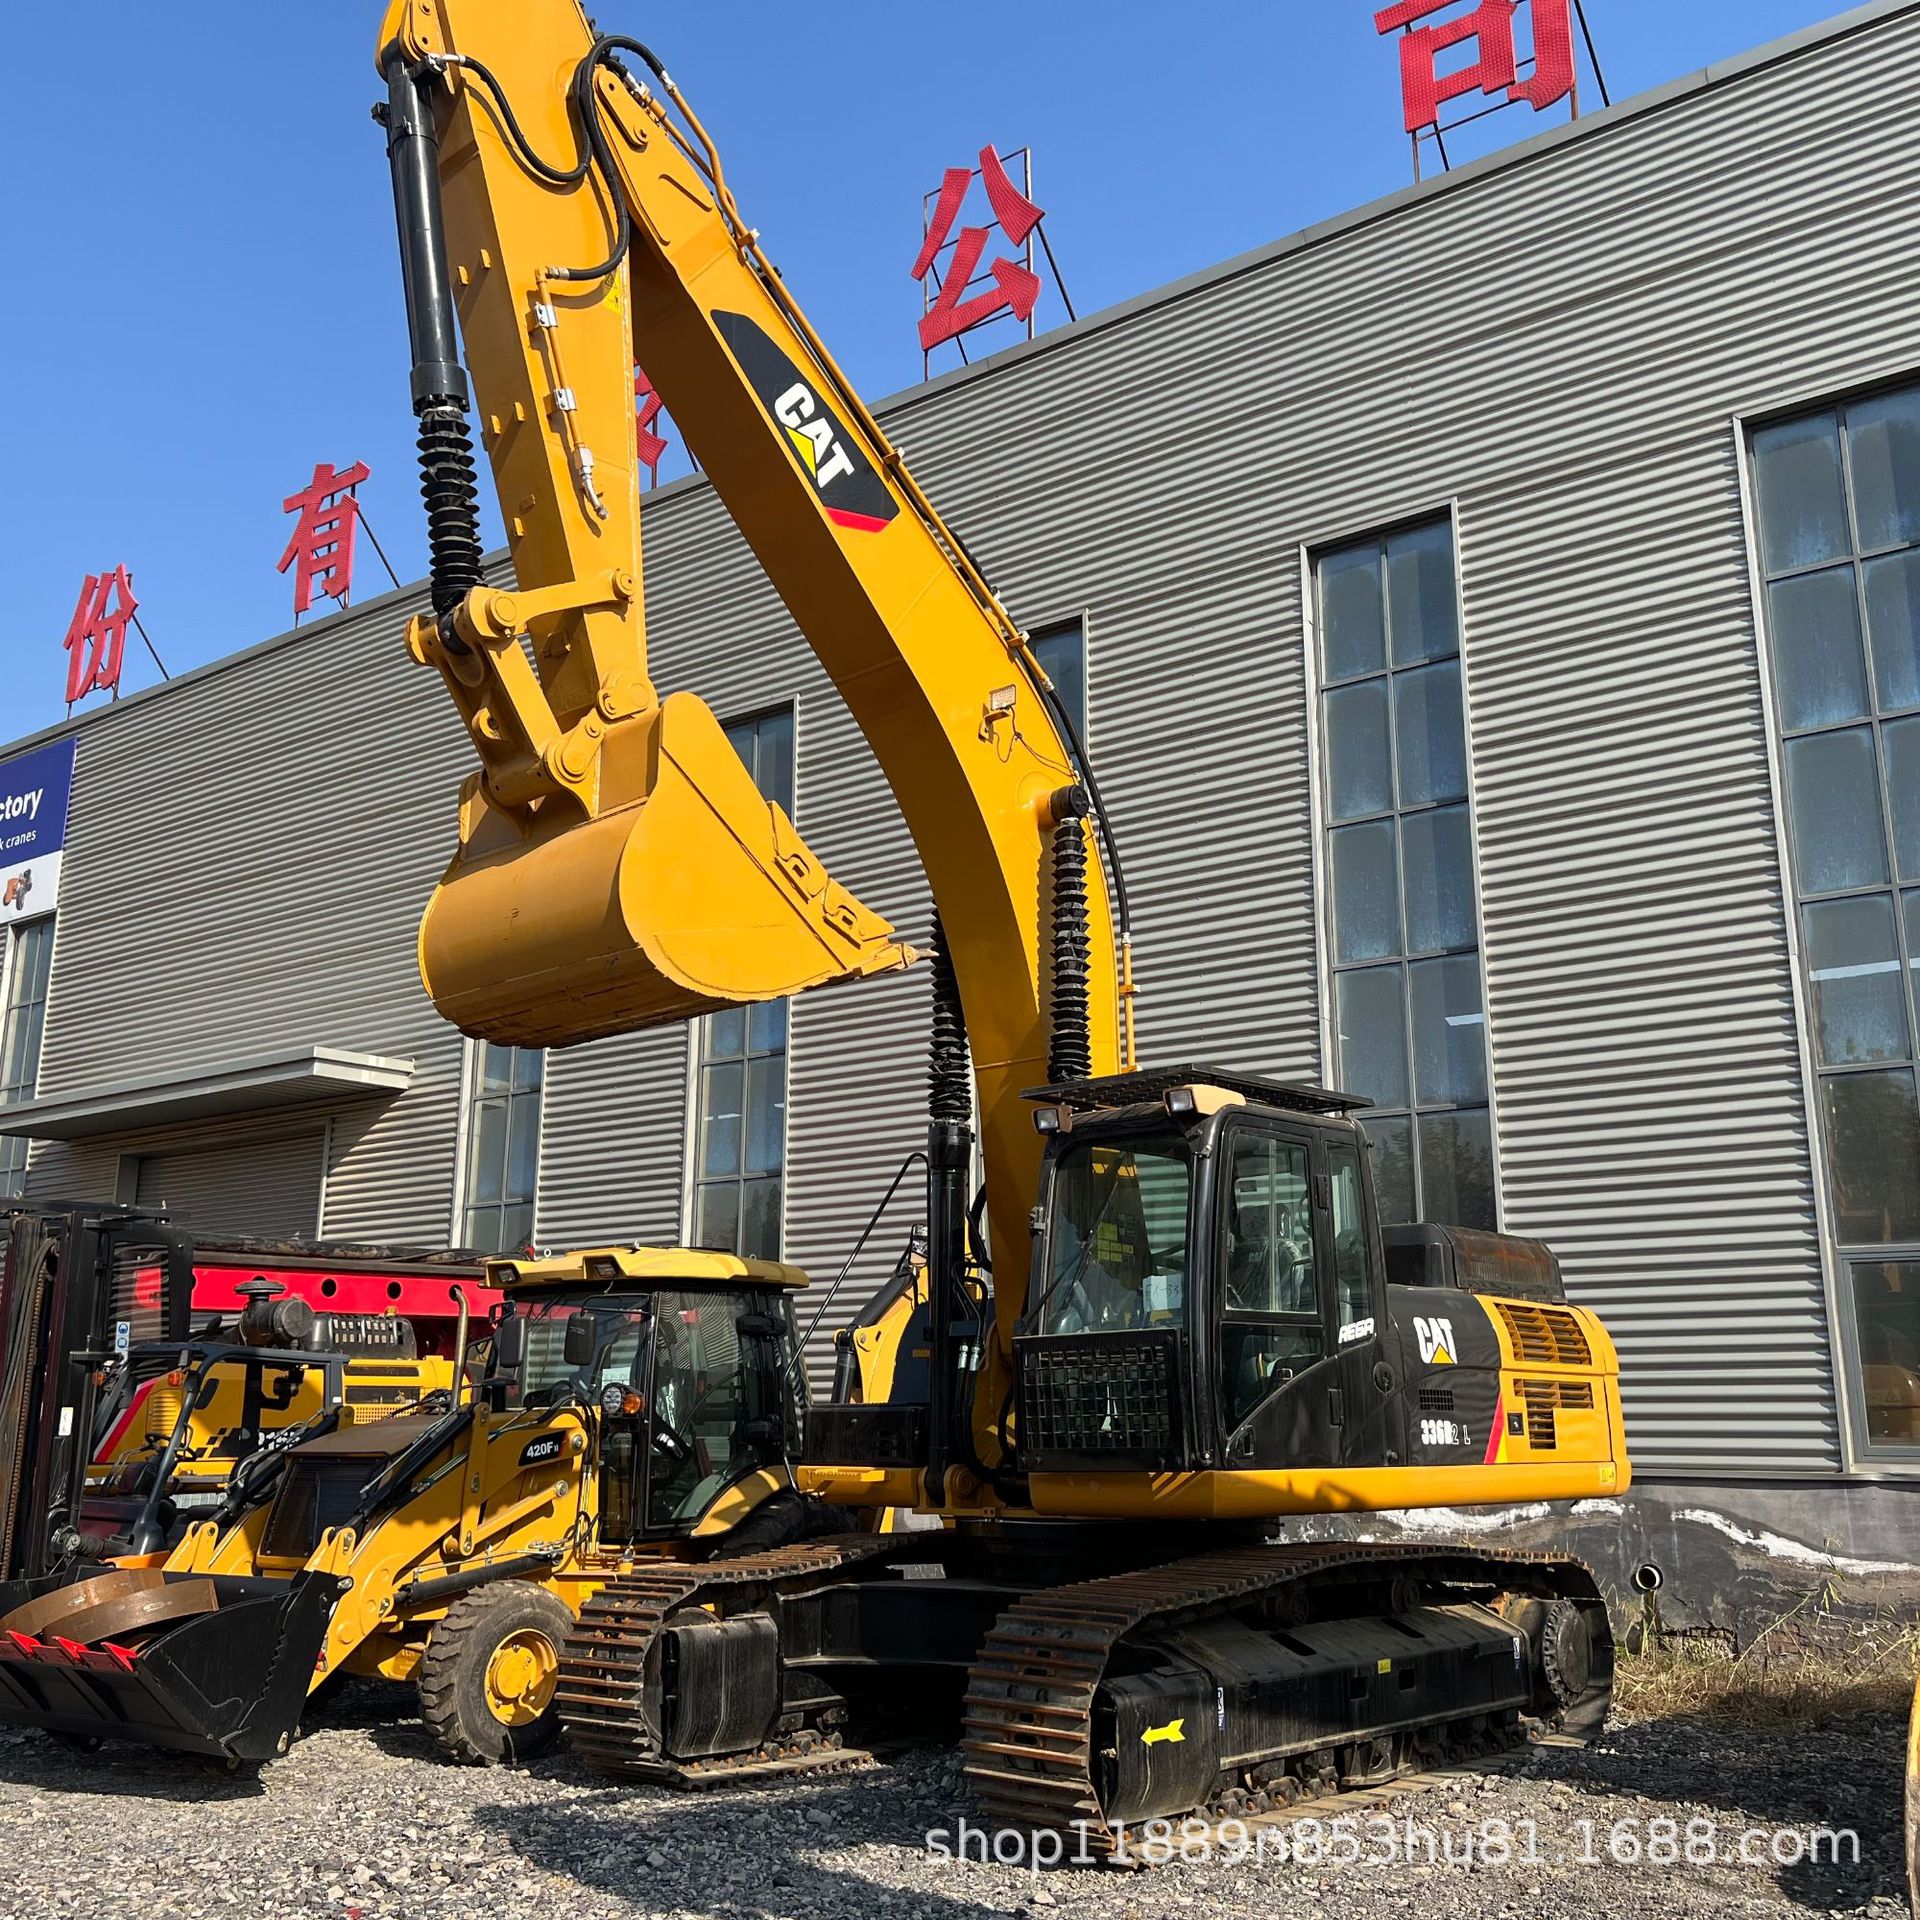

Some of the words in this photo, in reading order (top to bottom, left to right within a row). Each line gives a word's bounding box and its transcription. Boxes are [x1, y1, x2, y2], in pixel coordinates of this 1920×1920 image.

[775, 382, 855, 489] CAT
[6, 830, 37, 849] cranes
[1413, 1317, 1457, 1364] CAT
[526, 1441, 554, 1458] 420F
